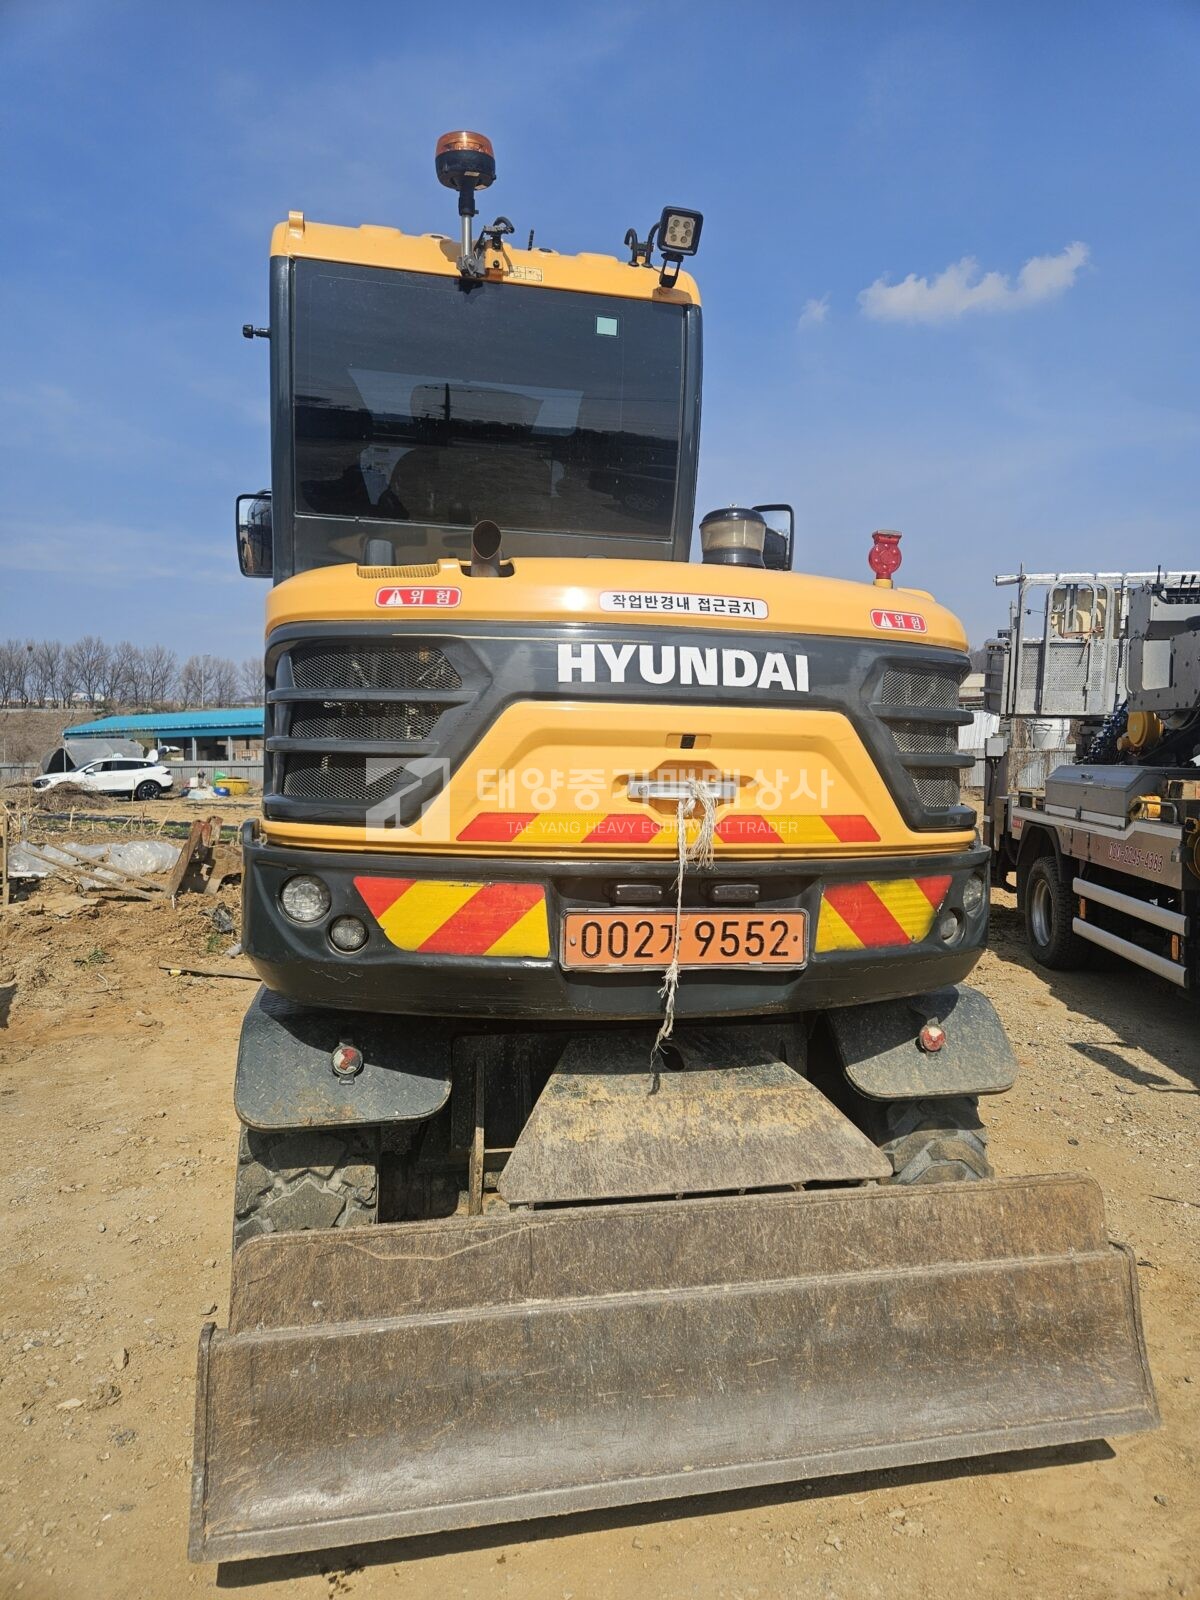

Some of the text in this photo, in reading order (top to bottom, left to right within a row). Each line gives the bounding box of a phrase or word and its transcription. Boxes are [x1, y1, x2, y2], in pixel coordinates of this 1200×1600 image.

[612, 594, 756, 615] 작업반경내 접근금지
[557, 643, 810, 693] HYUNDAI
[694, 920, 789, 957] 9552
